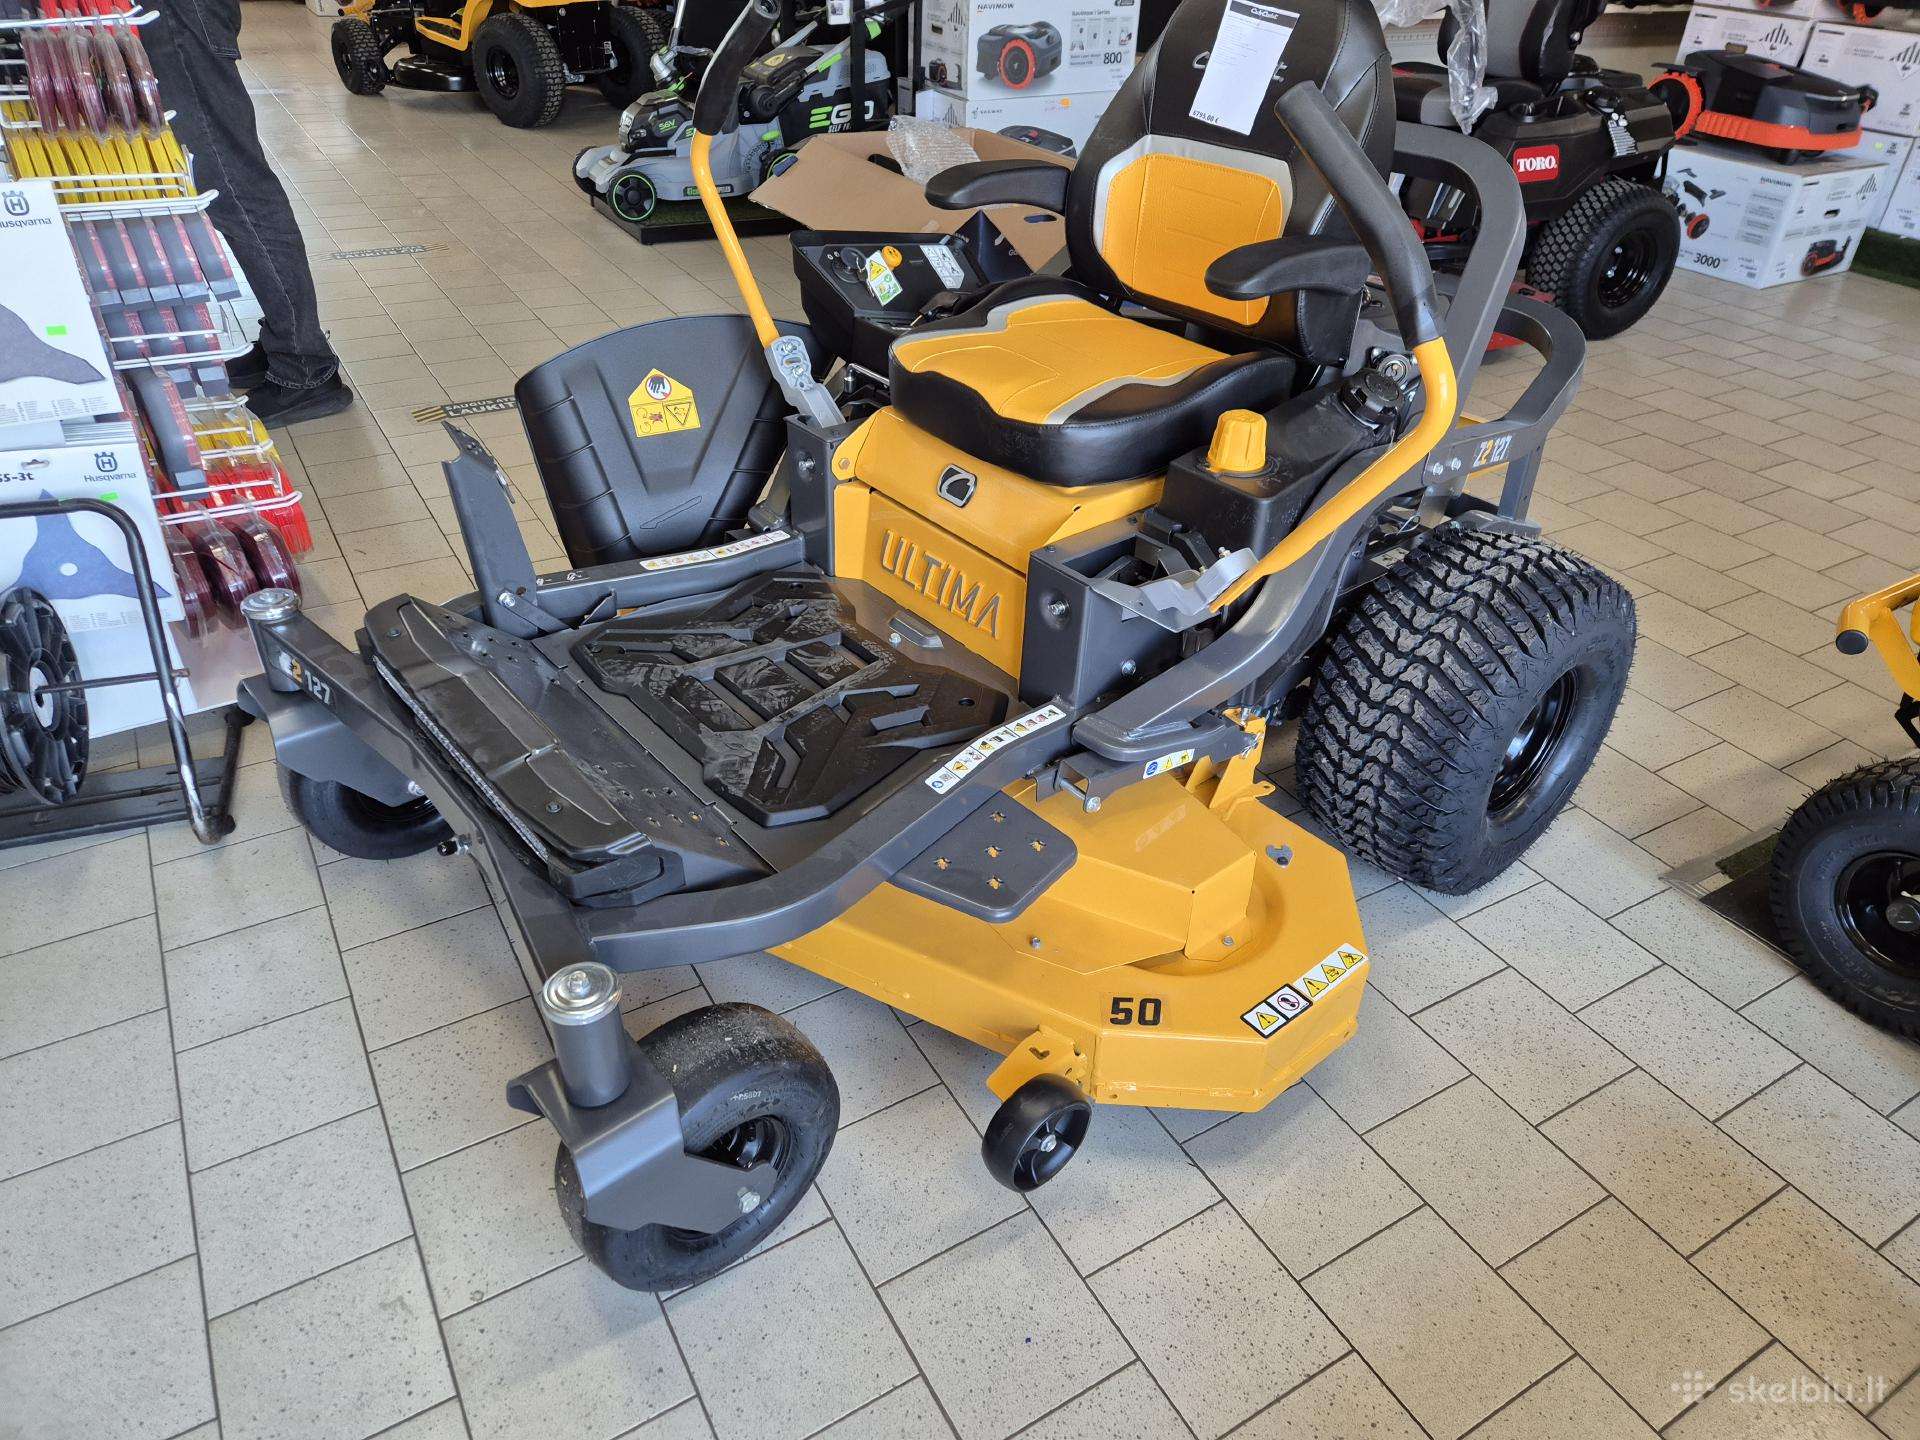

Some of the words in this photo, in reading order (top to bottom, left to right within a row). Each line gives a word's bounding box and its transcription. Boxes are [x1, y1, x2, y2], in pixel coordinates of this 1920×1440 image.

[1104, 52, 1122, 64] 800
[1517, 155, 1556, 172] TORO
[1693, 252, 1721, 269] 3000
[84, 472, 136, 482] Husqvarna
[881, 529, 1002, 640] ULTIMA
[305, 670, 330, 705] 127
[1110, 997, 1162, 1026] 50
